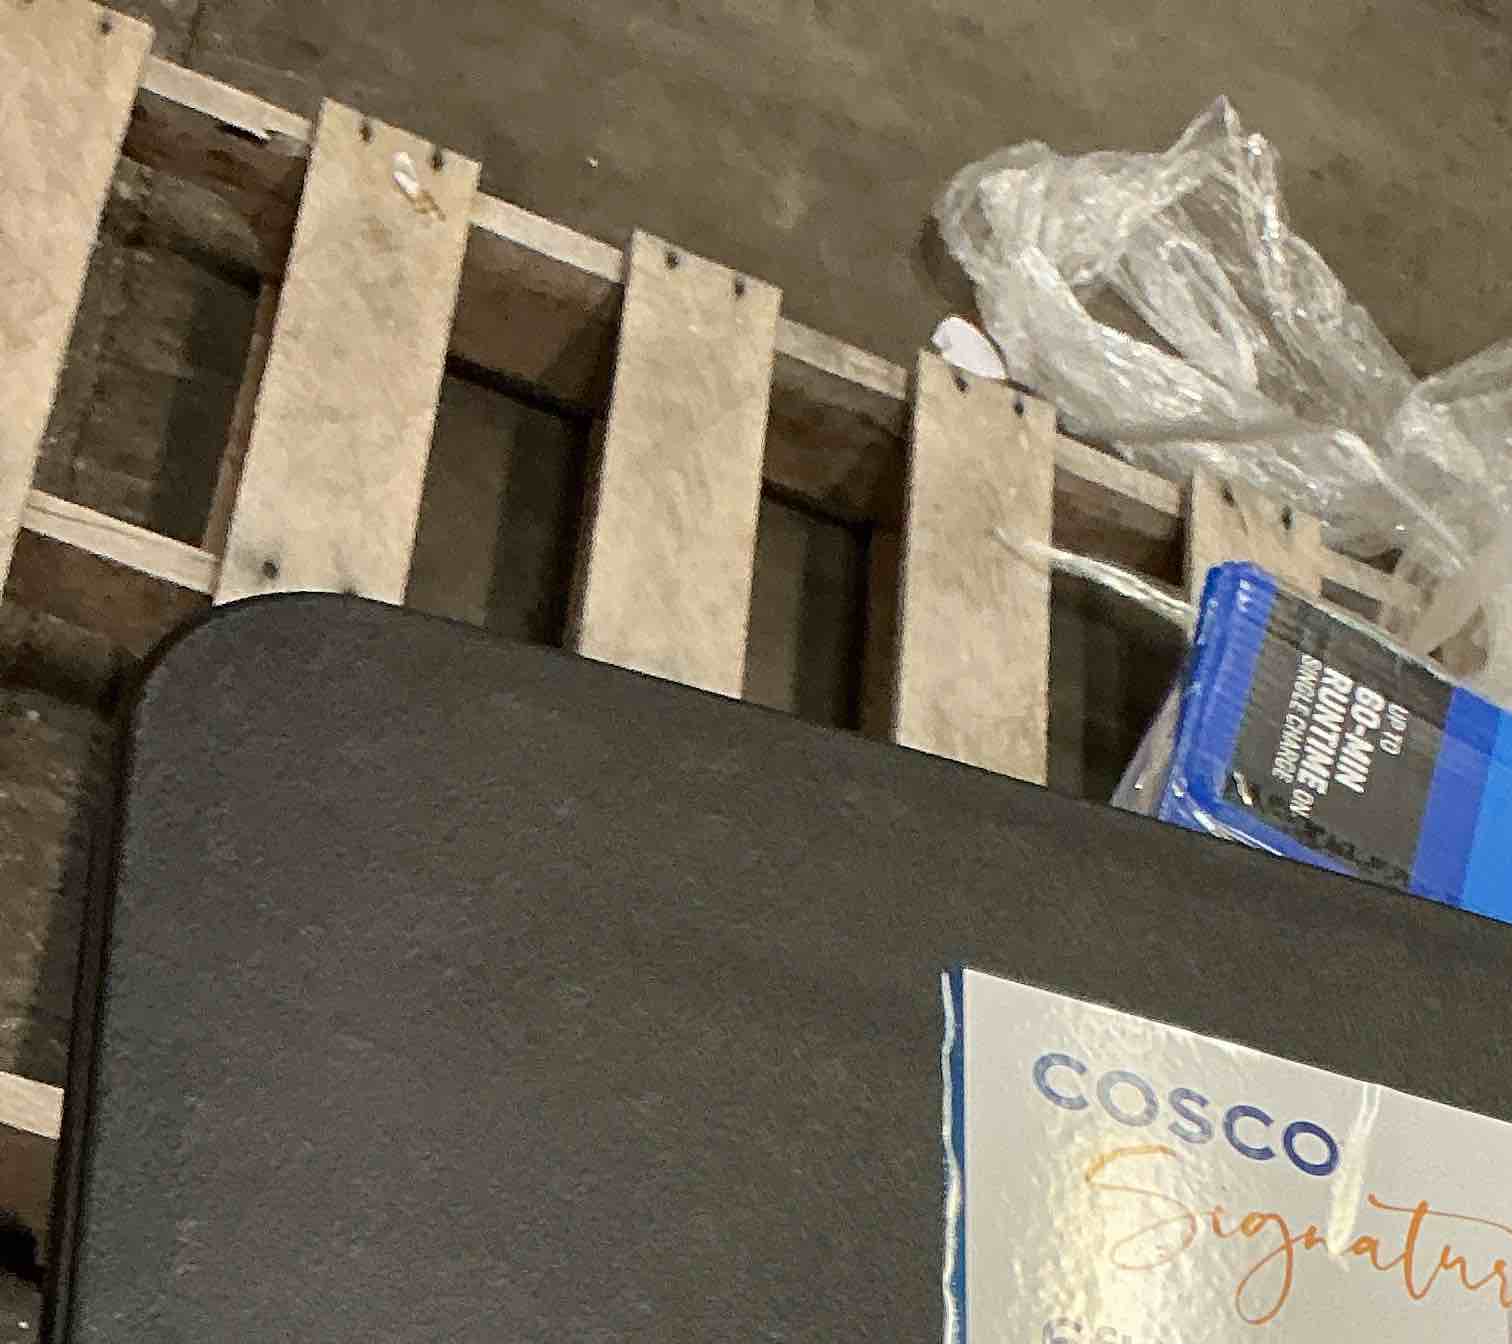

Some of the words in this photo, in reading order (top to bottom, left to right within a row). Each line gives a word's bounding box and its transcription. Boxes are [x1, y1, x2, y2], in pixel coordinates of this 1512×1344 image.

[1288, 653, 1323, 718] SINGLE
[1387, 702, 1410, 732] UP
[1271, 713, 1308, 784] CHARGE
[1296, 665, 1354, 795] RUNTIME
[1334, 685, 1386, 794] 60-MIN
[1379, 730, 1404, 756] TO
[1289, 788, 1315, 819] ON
[1032, 1051, 1340, 1177] COSCO
